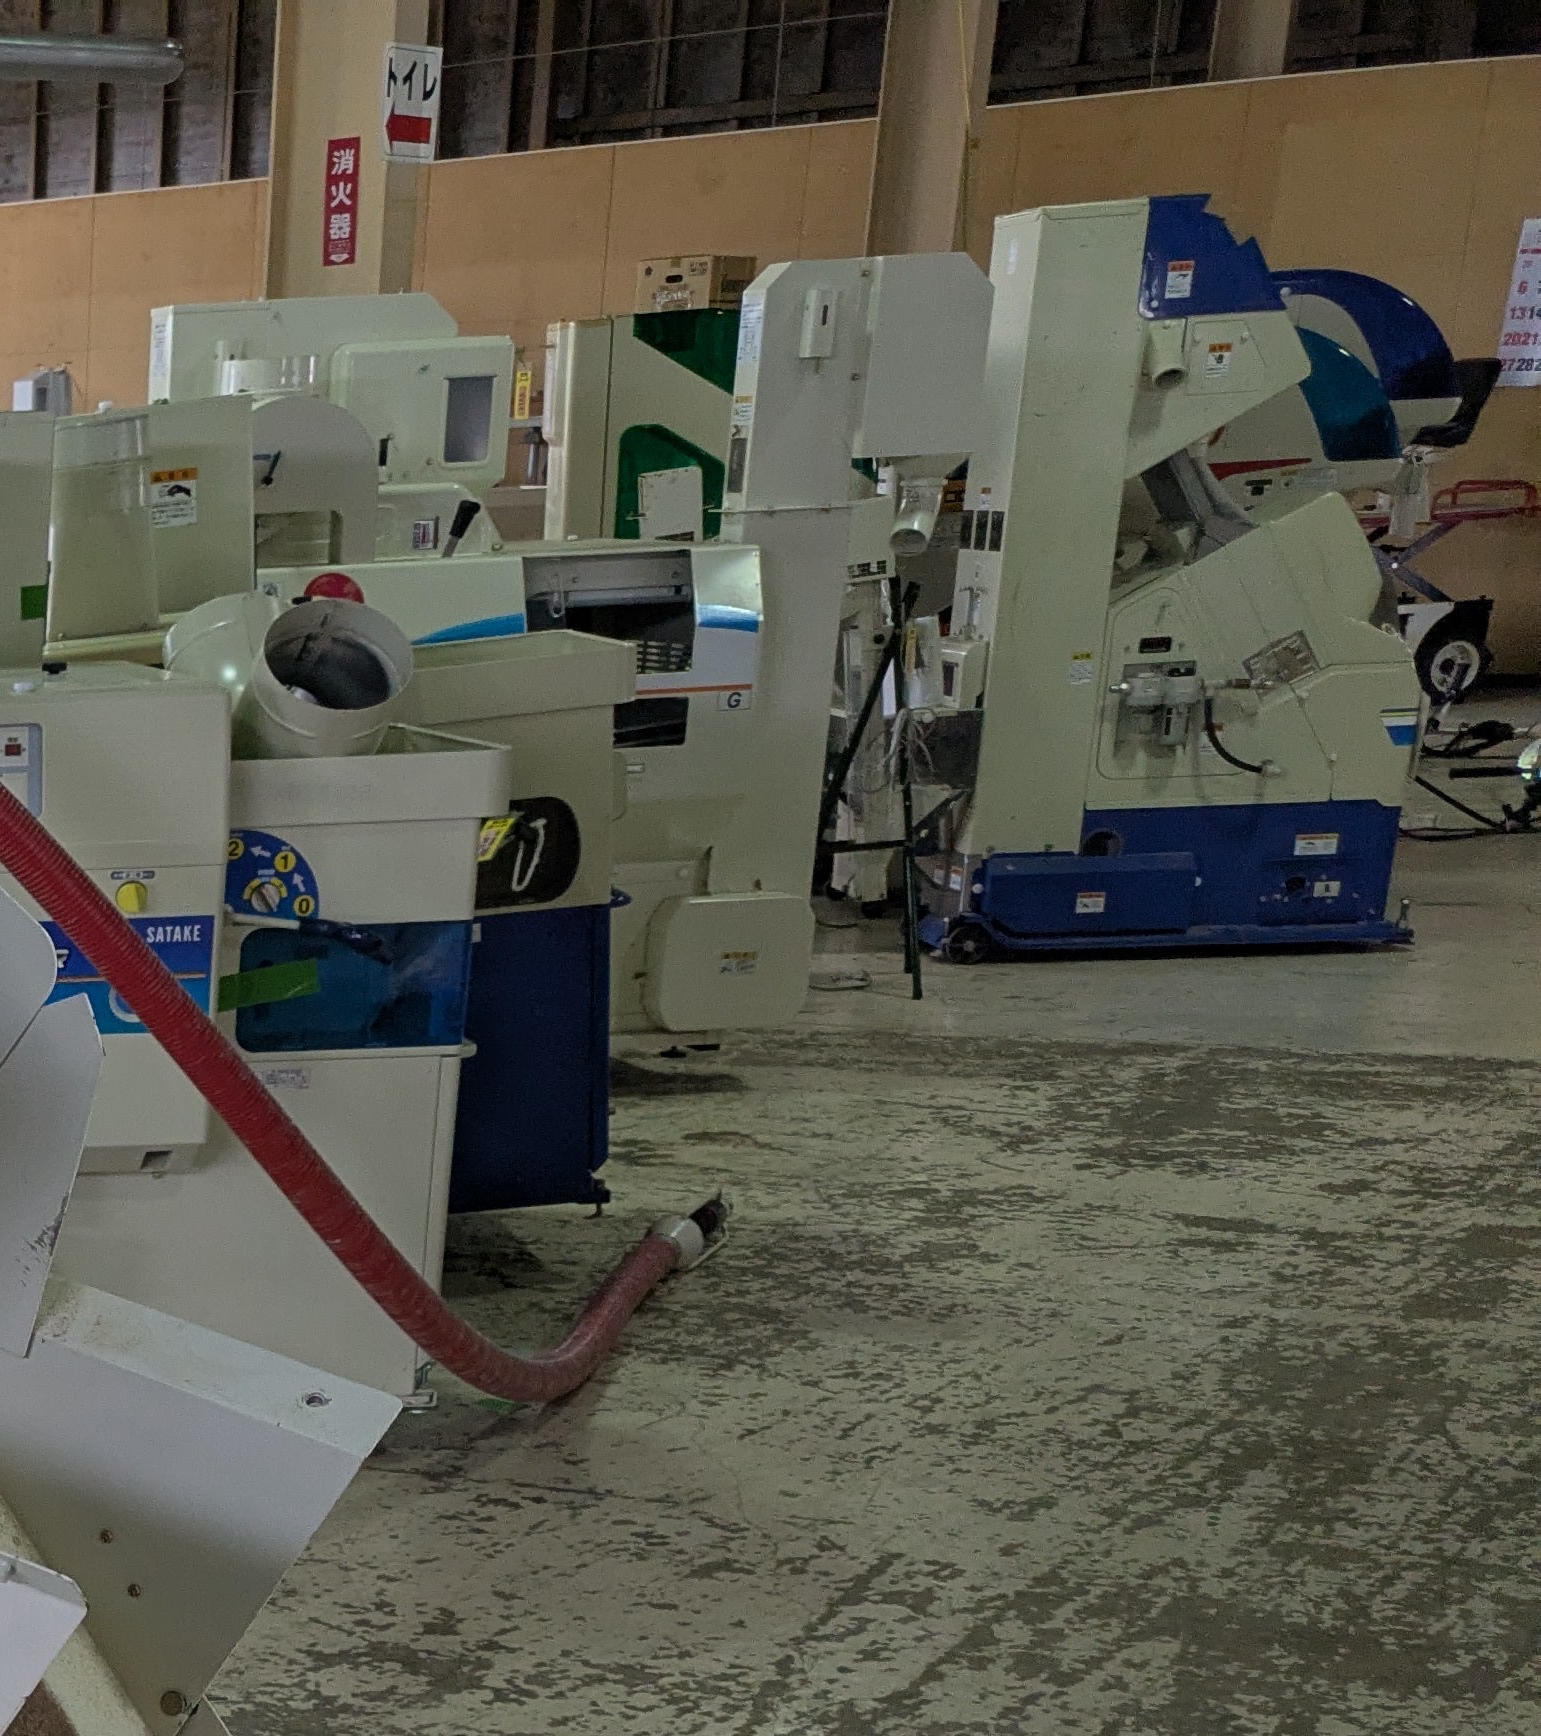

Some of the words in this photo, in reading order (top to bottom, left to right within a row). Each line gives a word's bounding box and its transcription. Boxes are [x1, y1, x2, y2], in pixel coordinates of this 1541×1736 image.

[386, 57, 438, 102] トイレ
[329, 148, 357, 241] 消火器
[727, 692, 742, 709] G
[228, 840, 241, 857] 2
[280, 854, 290, 870] 1
[298, 898, 310, 915] 0
[146, 924, 202, 944] SATAKE
